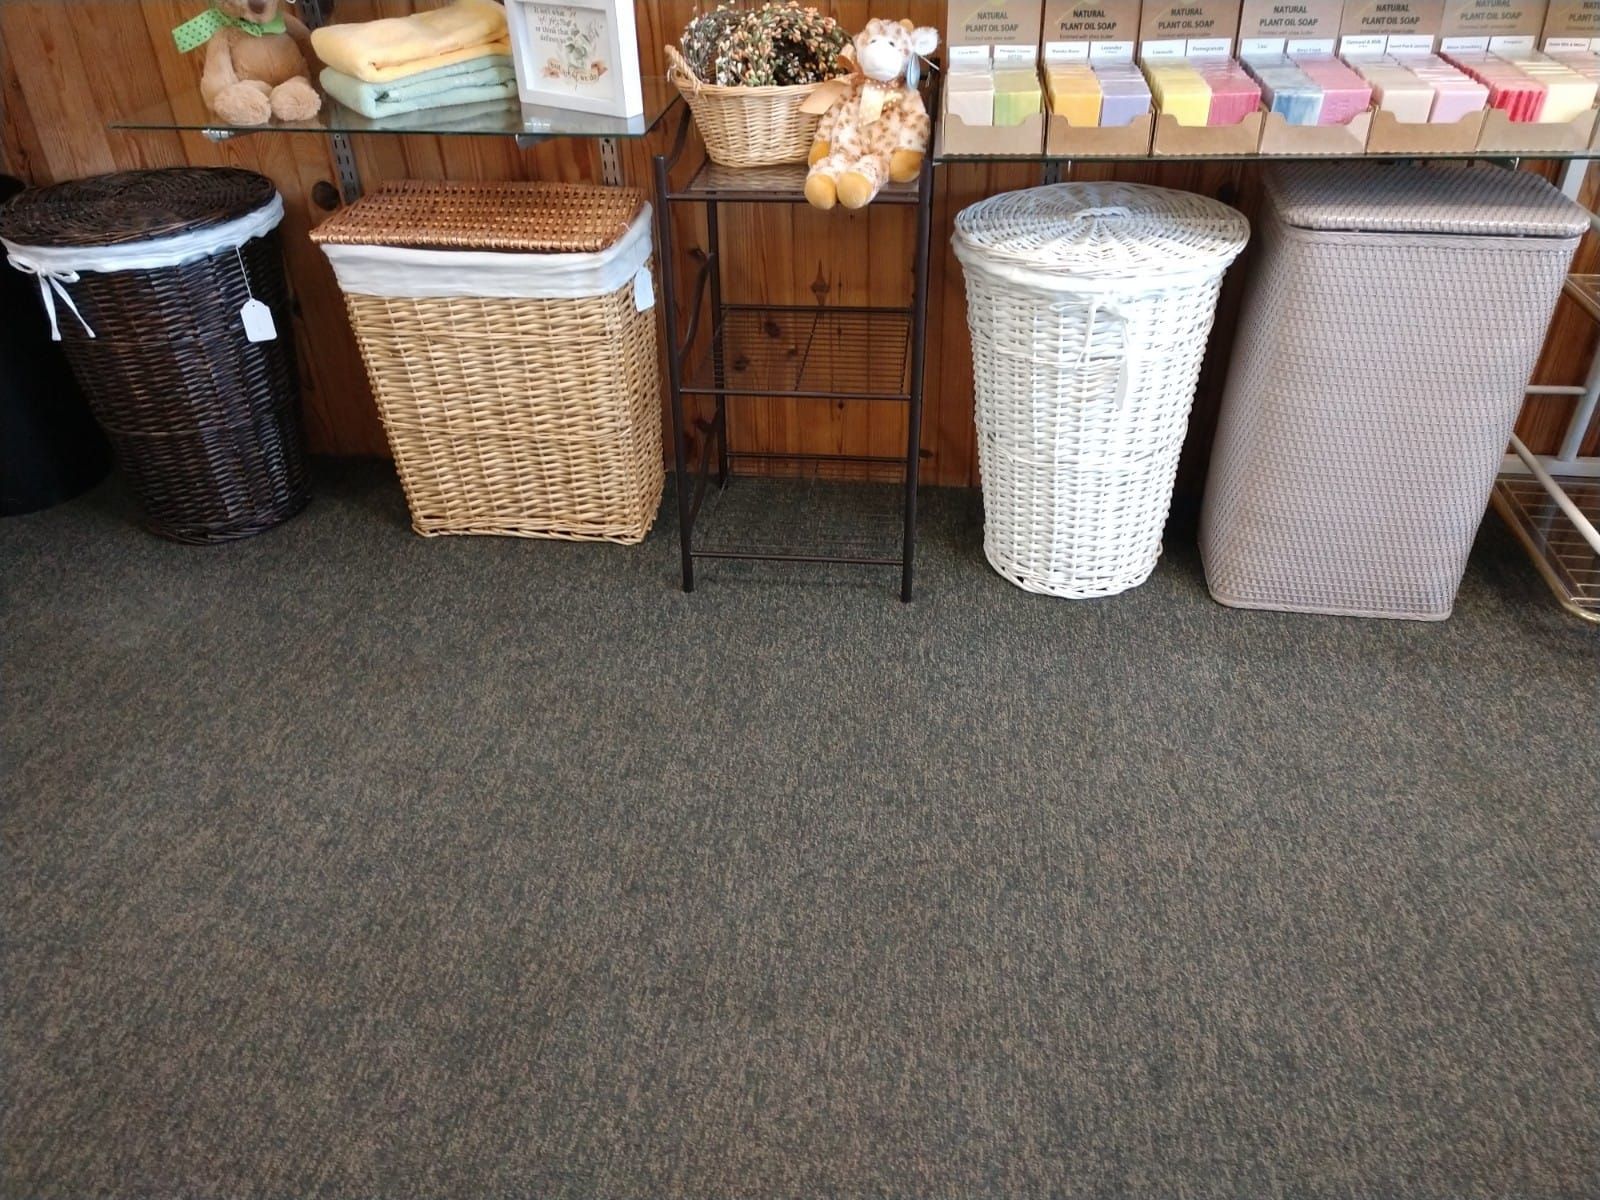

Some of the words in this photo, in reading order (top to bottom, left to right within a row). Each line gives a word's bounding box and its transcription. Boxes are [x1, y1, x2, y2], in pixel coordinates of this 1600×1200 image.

[1171, 8, 1203, 16] NATURAL
[1273, 5, 1307, 14] NATURAL
[1376, 4, 1409, 12] NATURAL
[977, 11, 1008, 20] NATURAL
[1073, 9, 1105, 17] NATURAL
[1460, 12, 1486, 20] PLANT
[1486, 12, 1499, 20] OIL
[1501, 11, 1522, 20] SOAP
[1568, 13, 1593, 22] PLANT
[1158, 21, 1181, 29] PLANT
[1181, 20, 1193, 29] OIL
[1195, 20, 1214, 28] SOAP
[1259, 18, 1283, 27] PLANT
[1284, 18, 1296, 26] OIL
[1298, 18, 1318, 26] SOAP
[1361, 16, 1386, 25] PLANT
[1386, 16, 1398, 25] OIL
[1400, 16, 1421, 25] SOAP
[965, 24, 987, 32] PLANT
[988, 24, 999, 32] OIL
[1001, 23, 1019, 32] SOAP
[1060, 22, 1083, 31] PLANT
[1084, 22, 1096, 30] OIL
[1097, 22, 1117, 30] SOAP
